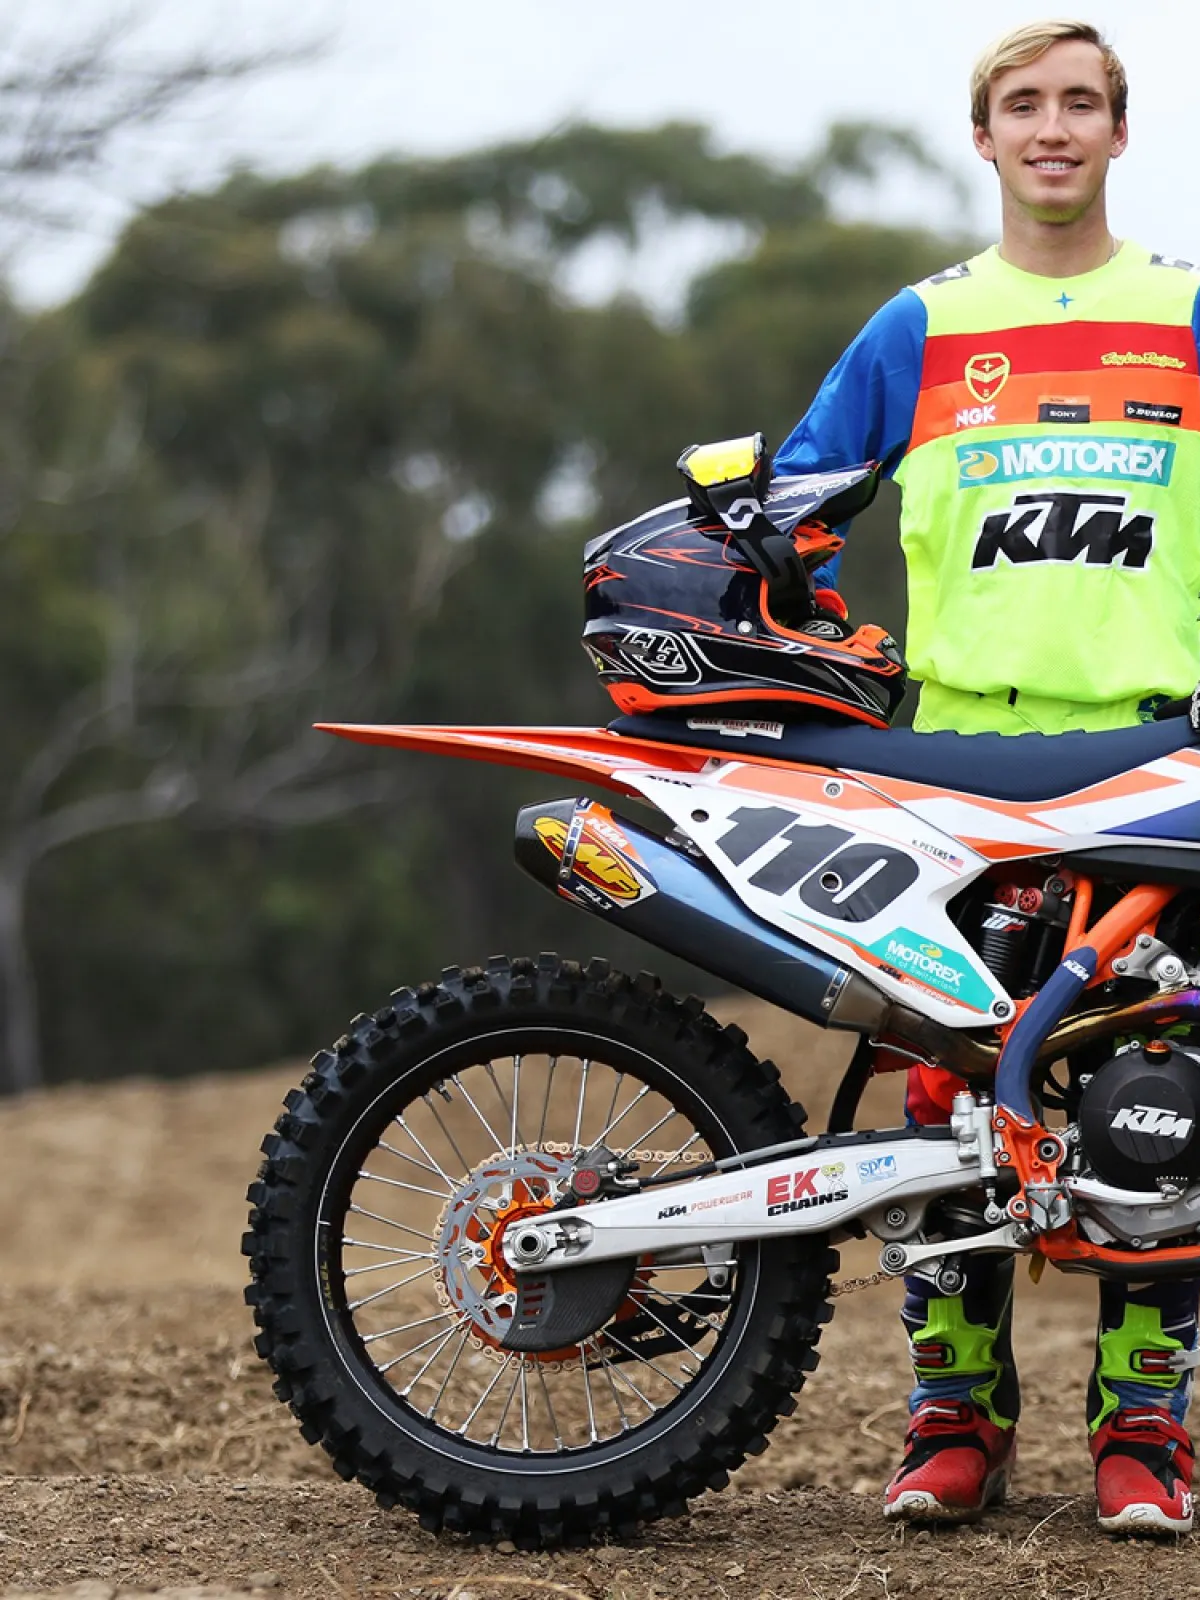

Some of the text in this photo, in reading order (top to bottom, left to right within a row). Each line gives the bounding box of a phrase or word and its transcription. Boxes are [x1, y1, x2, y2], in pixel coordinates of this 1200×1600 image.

[956, 405, 996, 427] NGK
[1049, 410, 1077, 418] SONY
[1136, 408, 1179, 419] DUNLOP
[1002, 441, 1167, 481] MOTOREX
[972, 493, 1154, 570] KTM
[716, 806, 920, 923] 110
[887, 939, 966, 987] MOTOREX
[1110, 1103, 1193, 1139] KTM
[767, 1167, 820, 1206] EK
[767, 1189, 849, 1217] CHAINS
[657, 1190, 753, 1220] KTM POWERWEAR
